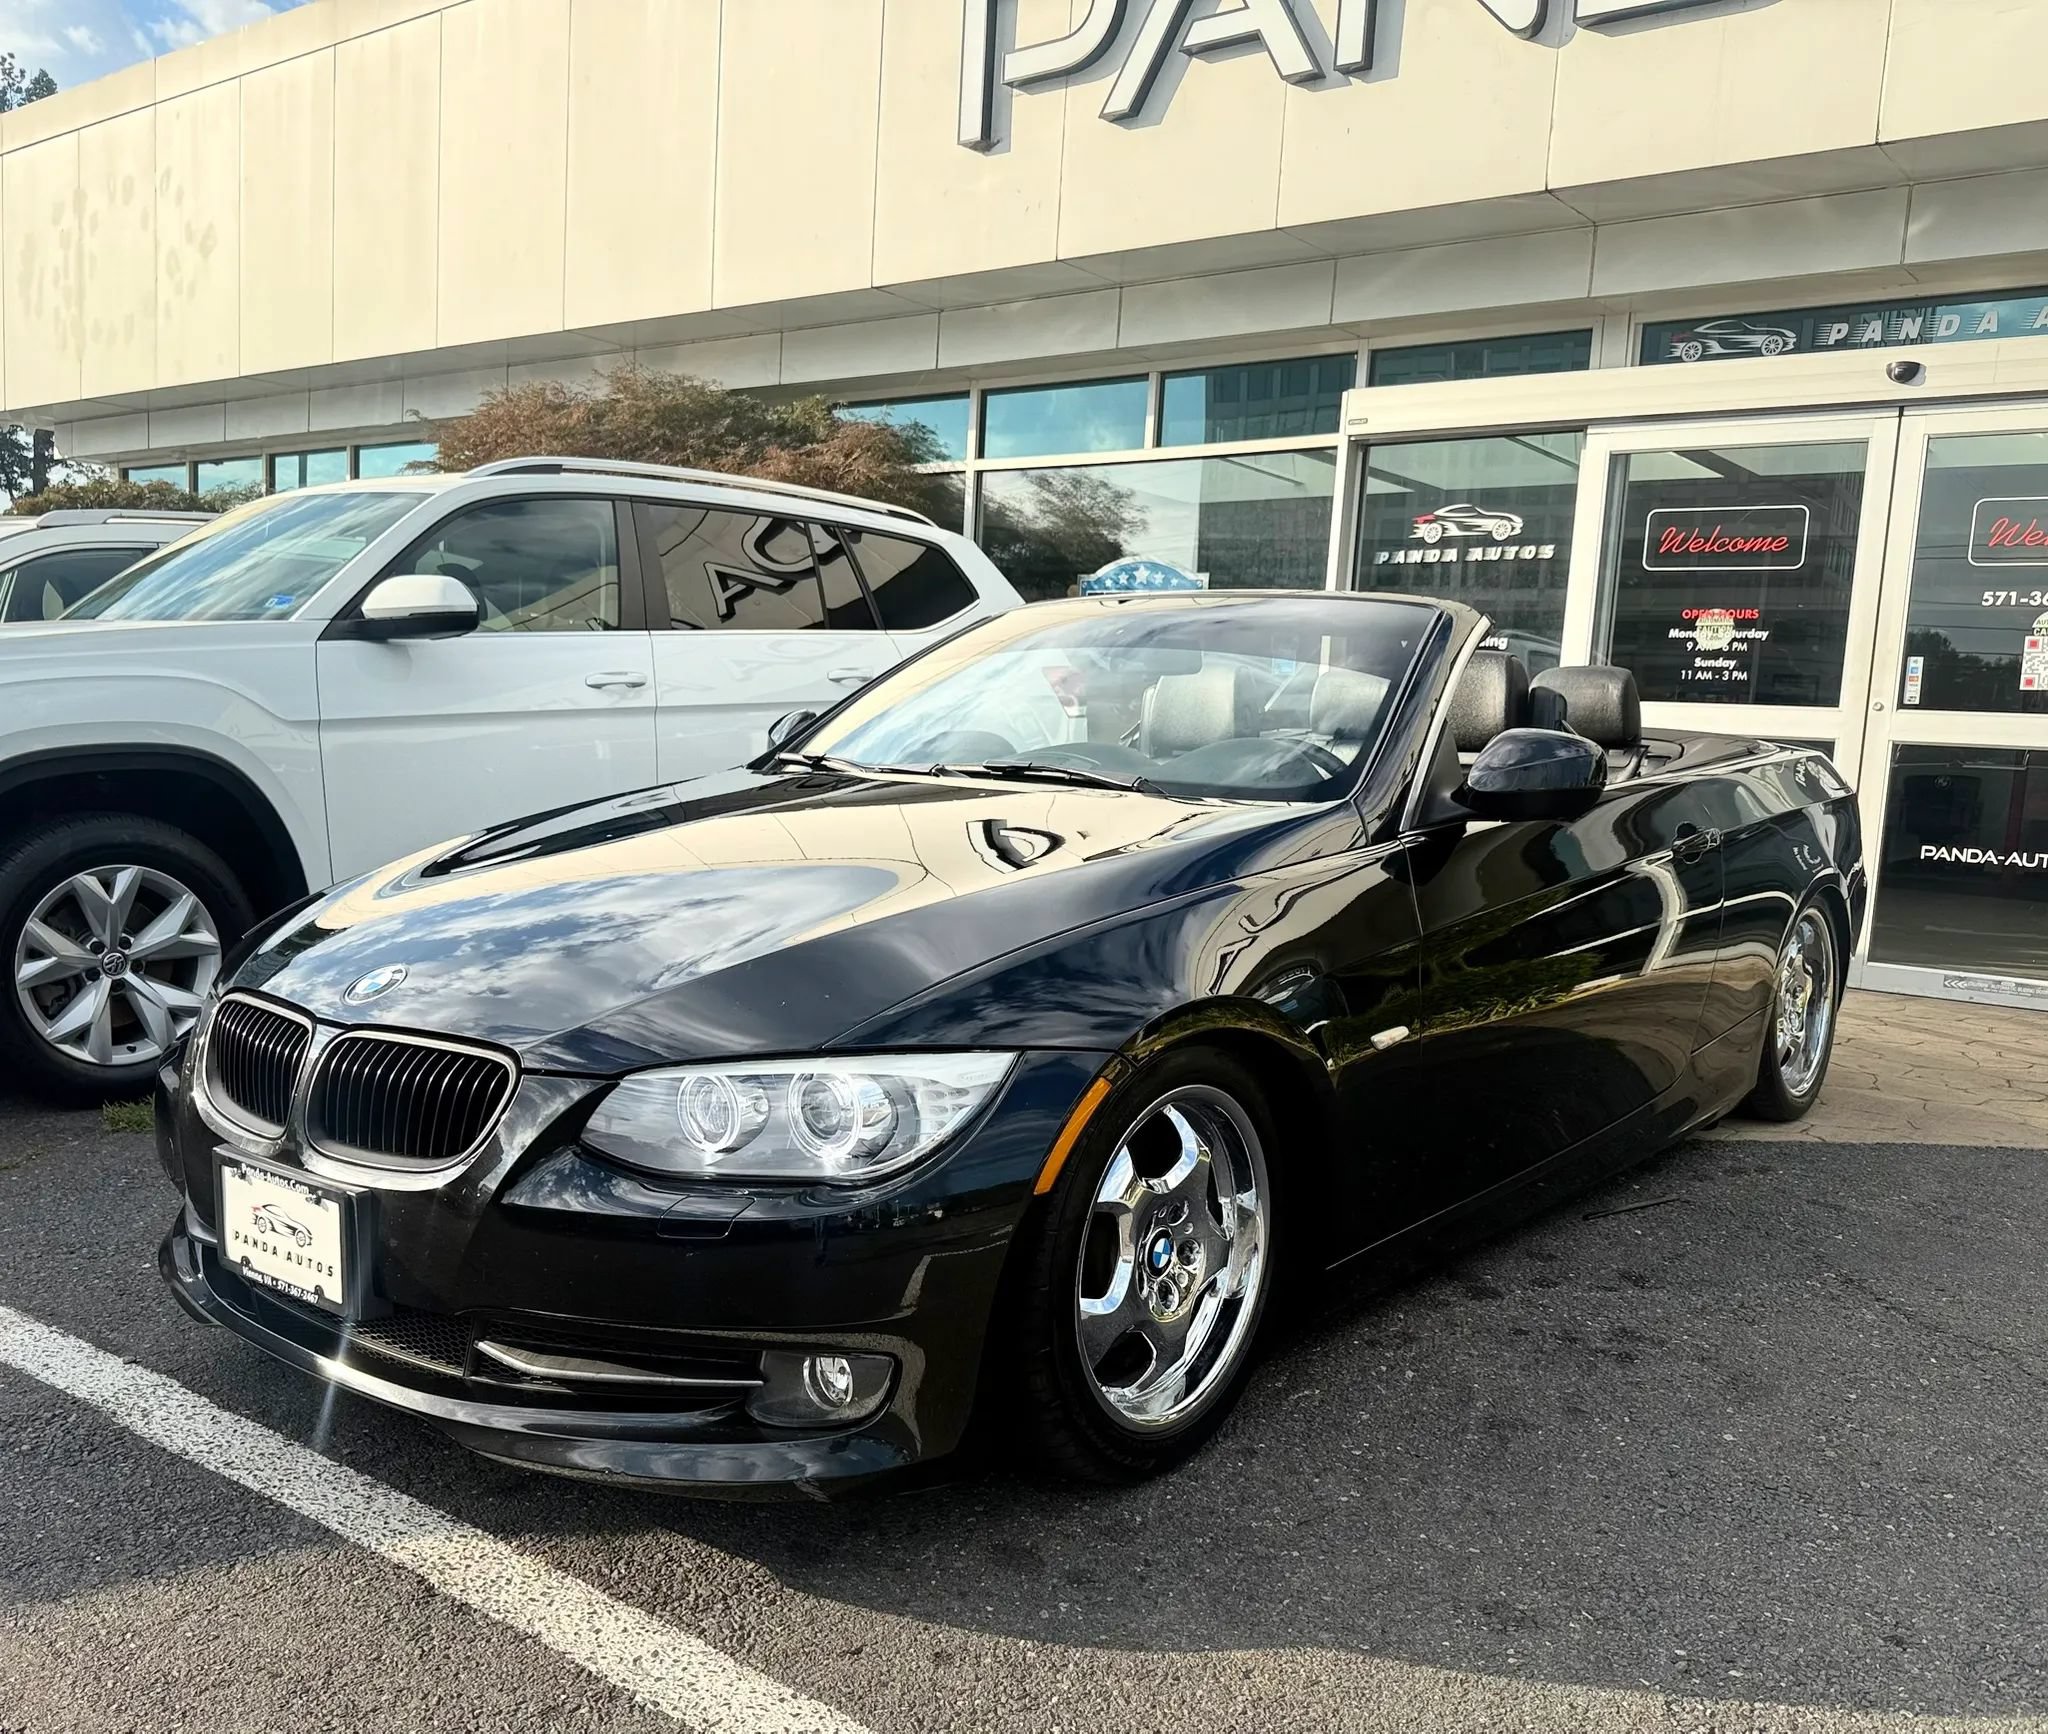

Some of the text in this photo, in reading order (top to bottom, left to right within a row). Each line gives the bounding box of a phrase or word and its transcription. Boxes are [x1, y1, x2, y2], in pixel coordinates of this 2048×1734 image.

[1815, 310, 1999, 345] PANDA
[1659, 525, 1790, 554] Welcome
[1373, 544, 1556, 565] PANDA AUTOS
[1478, 634, 1509, 651] ing
[1686, 641, 1694, 652] 9
[1722, 642, 1730, 652] 6
[1732, 642, 1748, 652] PM
[1694, 656, 1737, 670] Sunday
[1681, 670, 1692, 680] 11
[1695, 671, 1713, 681] AM
[1722, 670, 1730, 681] 3
[1732, 671, 1748, 681] PM
[241, 1163, 309, 1194] Panda-Autos.Com
[234, 1230, 334, 1277] PANDA AUTOS
